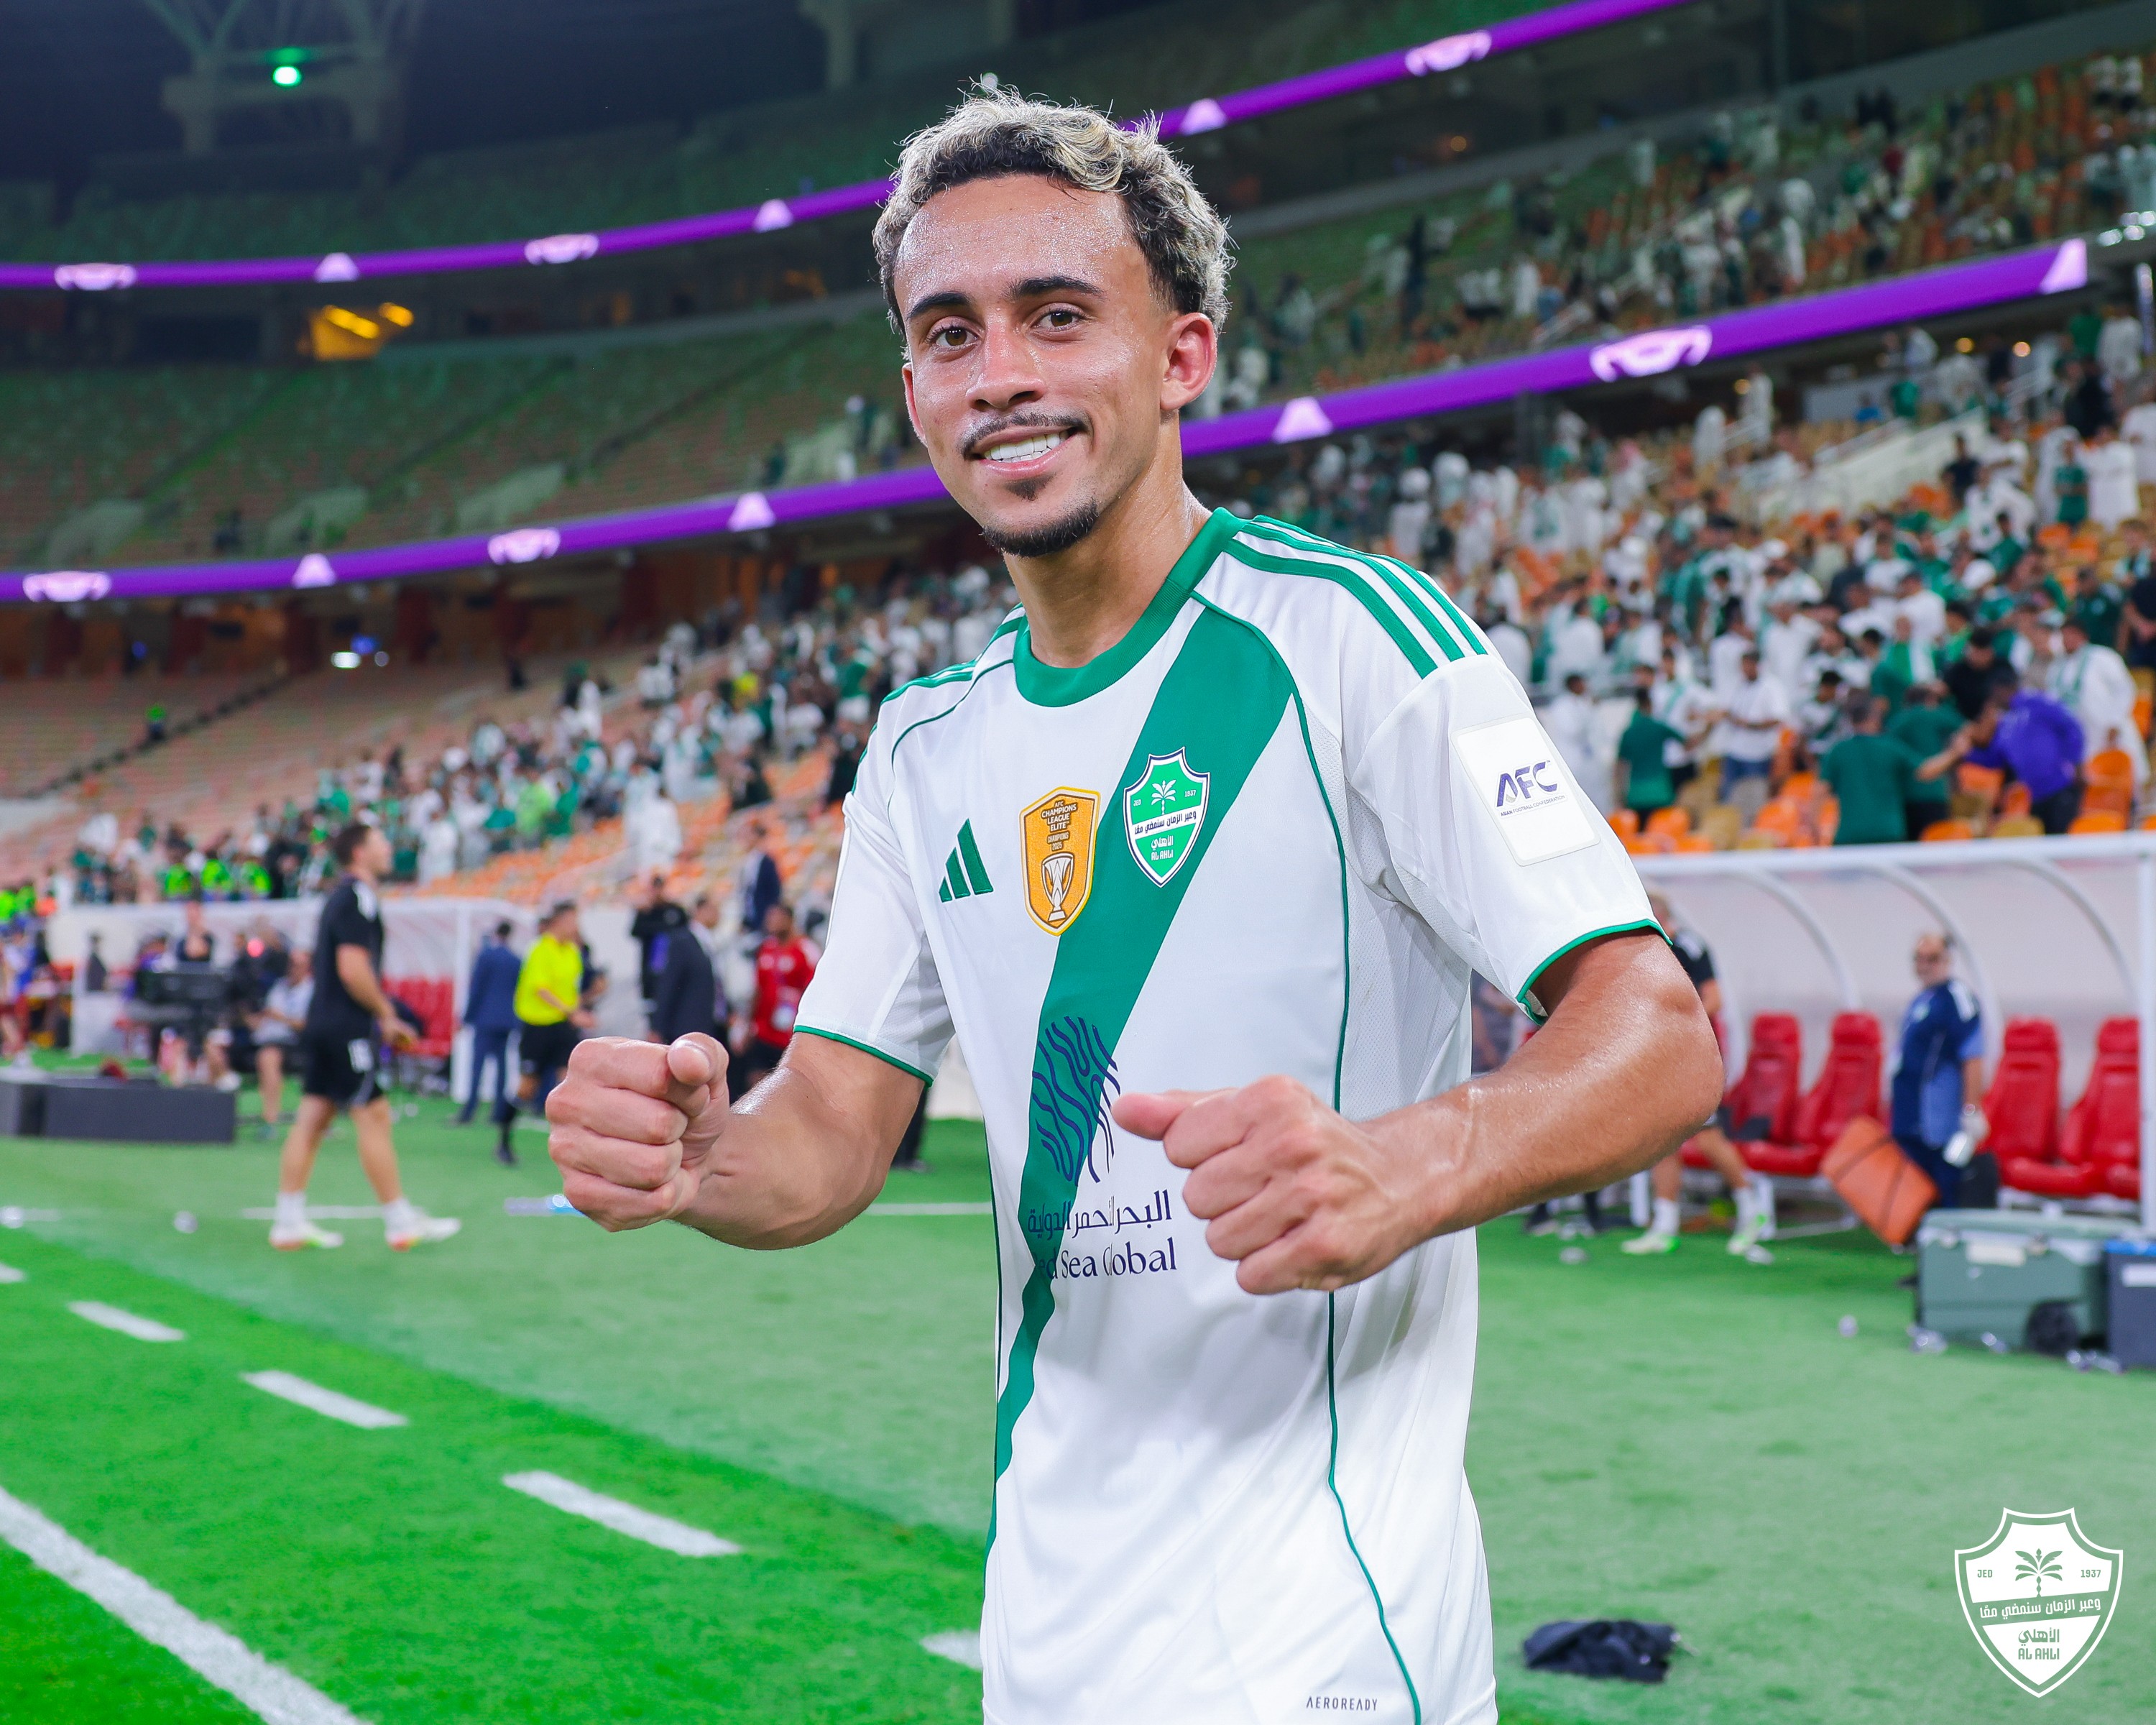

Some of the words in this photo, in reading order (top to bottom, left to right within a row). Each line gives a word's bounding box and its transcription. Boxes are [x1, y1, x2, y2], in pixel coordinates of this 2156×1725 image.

[1496, 761, 1558, 807] AFC
[1184, 789, 1197, 798] 1937
[1041, 804, 1077, 818] CHAMPIONS
[1513, 804, 1533, 813] FOOTBALL
[1532, 795, 1565, 807] CONFEDERATION
[1047, 812, 1070, 824] LEAGUE
[1166, 813, 1183, 827] الزمان
[1184, 811, 1197, 822] وعبر
[1050, 822, 1067, 832] ELITE
[1145, 819, 1165, 834] سنمضي
[1047, 832, 1069, 843] CHAMPIONS
[1151, 851, 1159, 861] AL
[1159, 849, 1174, 859] AHLI
[1114, 1190, 1173, 1234] البحر
[1028, 1200, 1071, 1241] الدولية
[1061, 1250, 1099, 1279] Sea
[1306, 1696, 1378, 1711] AEROREADY
